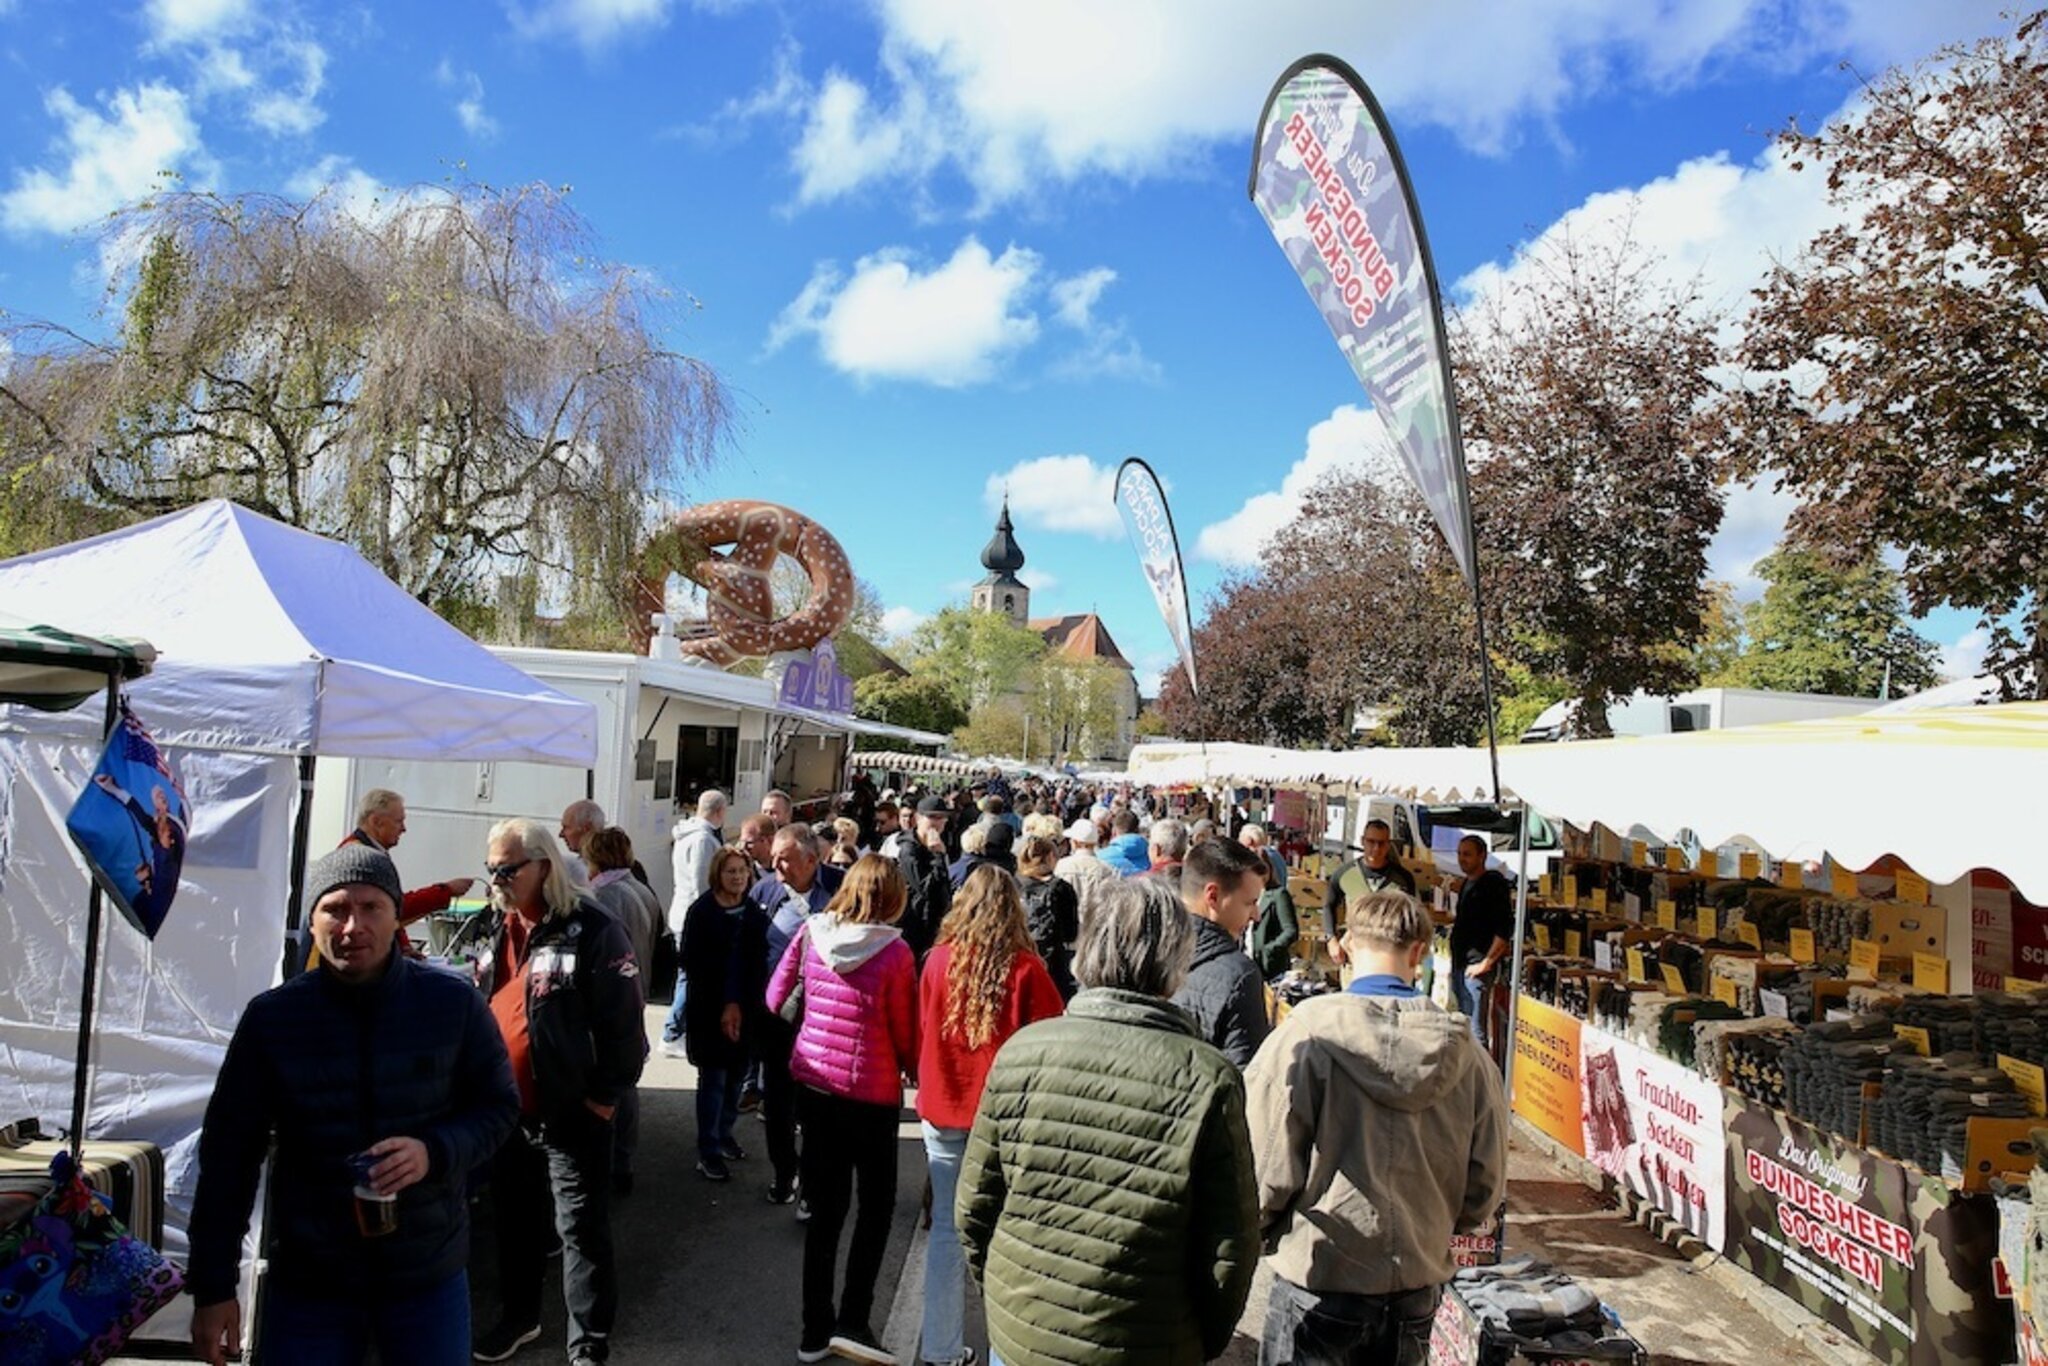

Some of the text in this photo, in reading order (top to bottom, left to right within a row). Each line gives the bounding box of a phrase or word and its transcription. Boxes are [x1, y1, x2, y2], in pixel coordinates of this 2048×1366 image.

[1636, 1067, 1703, 1126] Trachten-
[1647, 1111, 1695, 1164] Socken
[1778, 1135, 1868, 1198] Das Original!
[1747, 1150, 1915, 1269] BUNDESHEER
[1778, 1202, 1883, 1291] SOCKEN
